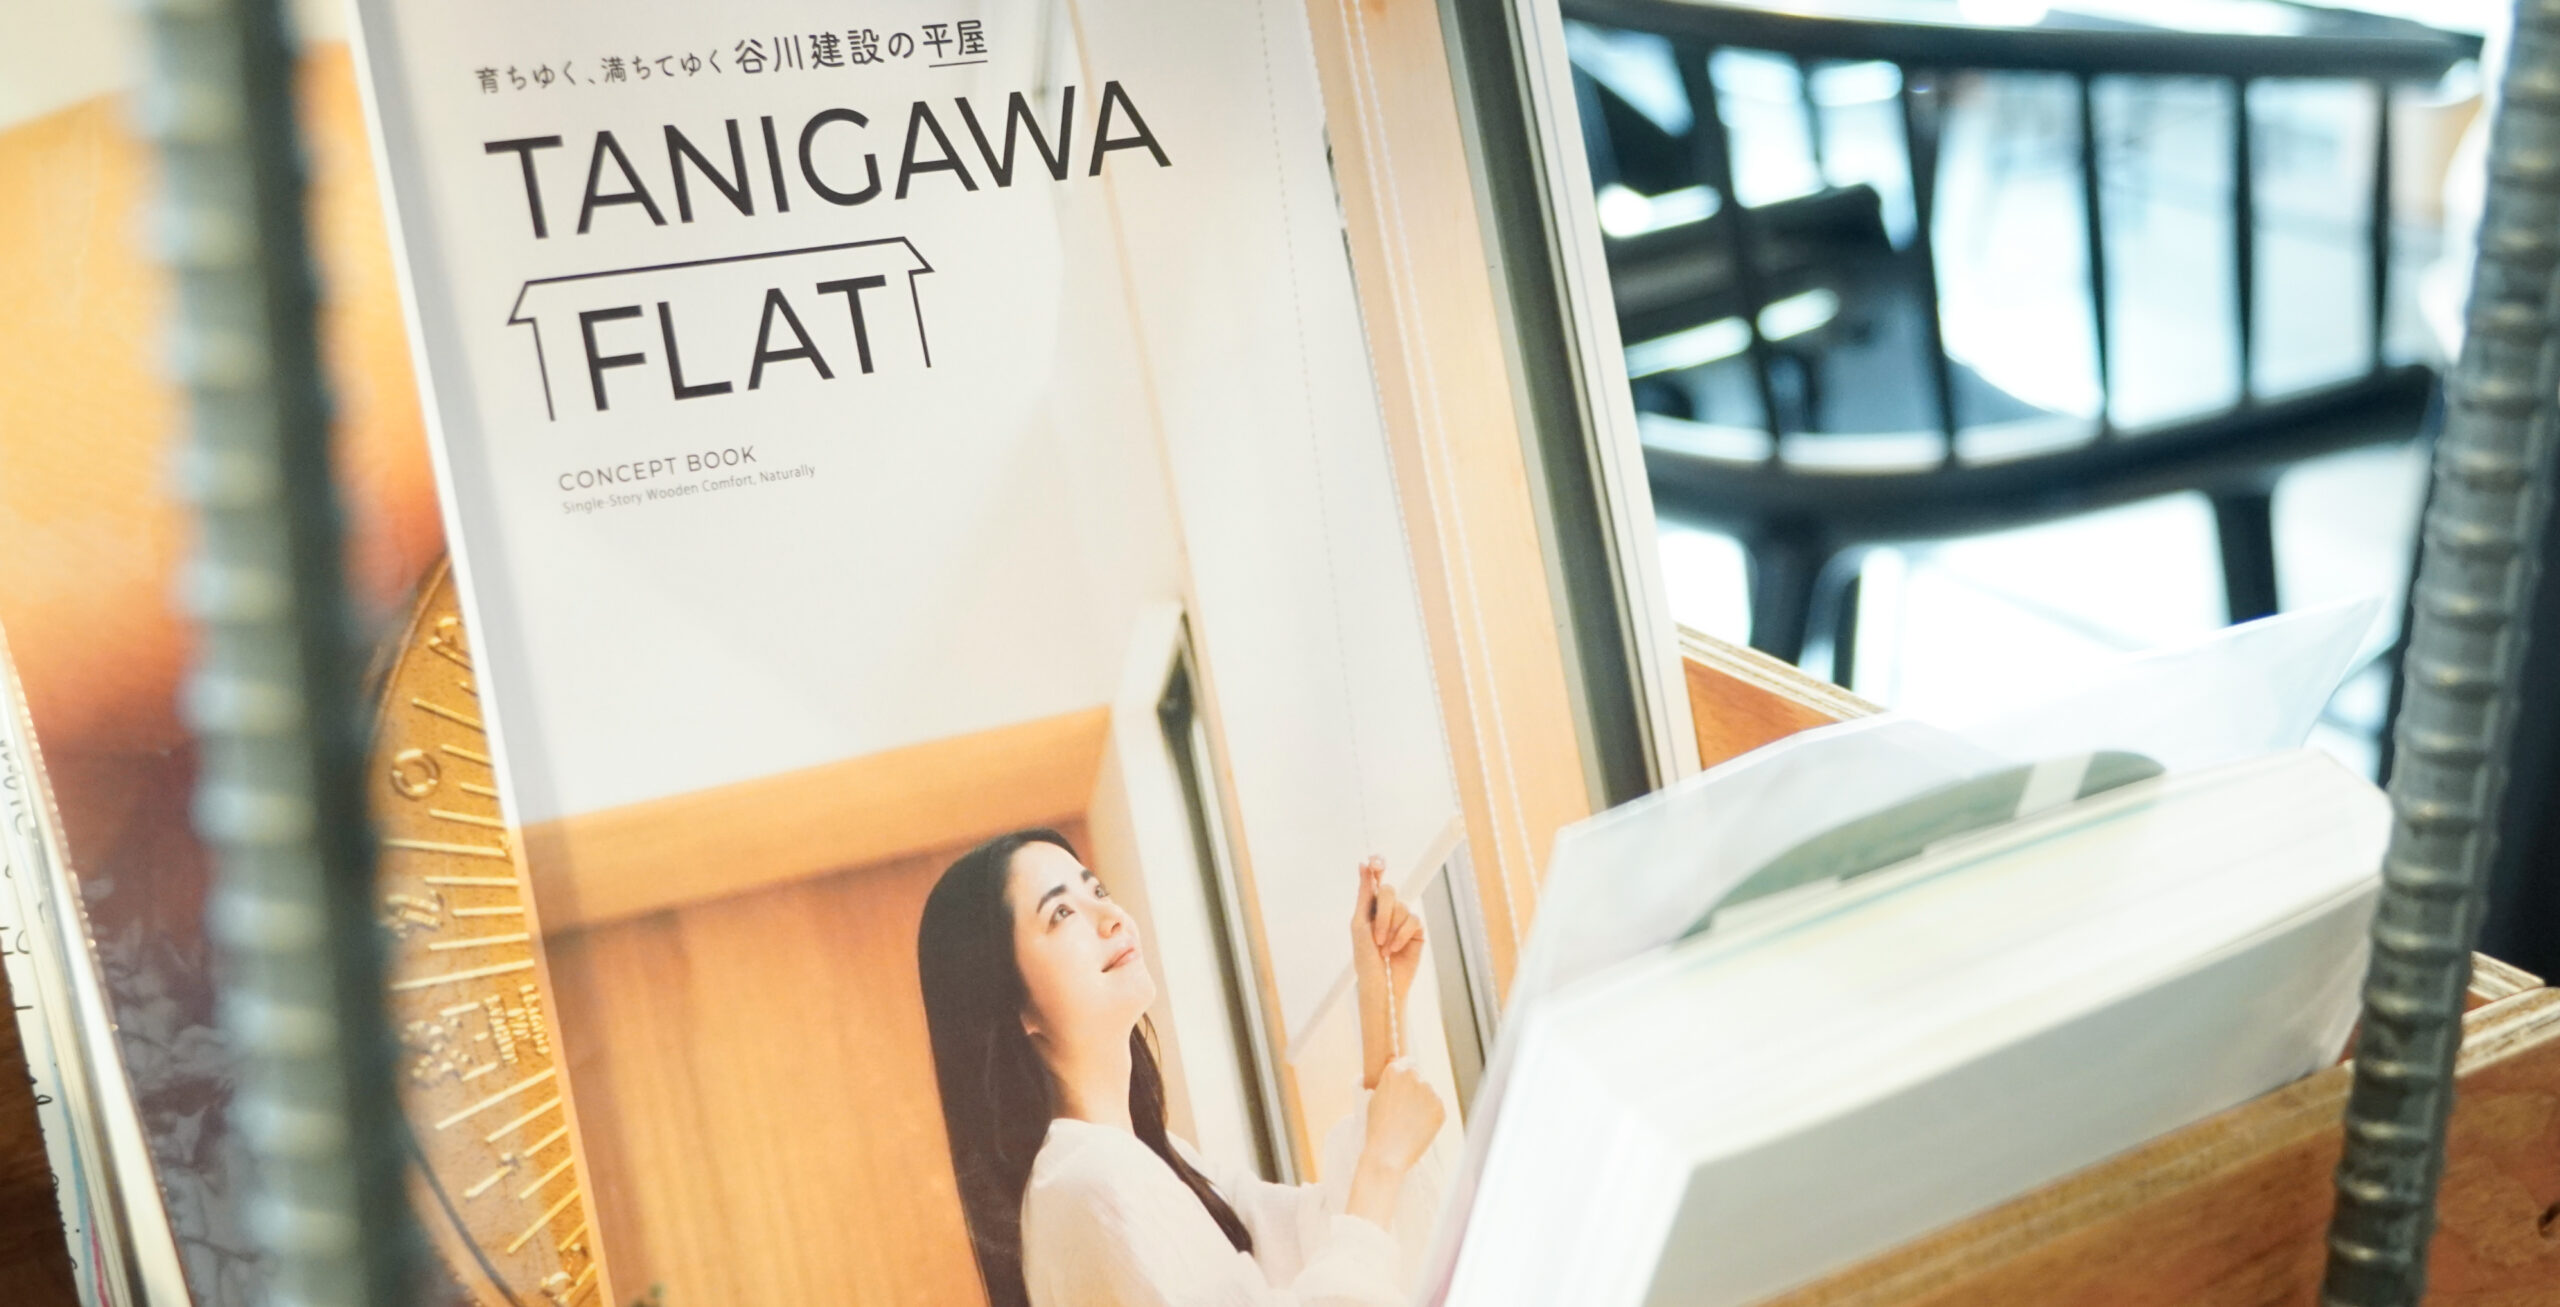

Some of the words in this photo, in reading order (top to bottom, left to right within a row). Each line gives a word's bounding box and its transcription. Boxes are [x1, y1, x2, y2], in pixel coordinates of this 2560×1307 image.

[475, 49, 723, 94] 育ちゆく、満ちてゆく
[735, 19, 988, 74] 谷川建設の平屋
[484, 80, 1172, 240] TANIGAWA
[578, 274, 887, 411] FLAT
[558, 457, 677, 491] CONCEPT
[687, 445, 756, 472] BOOK
[563, 491, 642, 514] Single-Story
[646, 483, 699, 501] Wooden
[759, 463, 815, 483] Naturally
